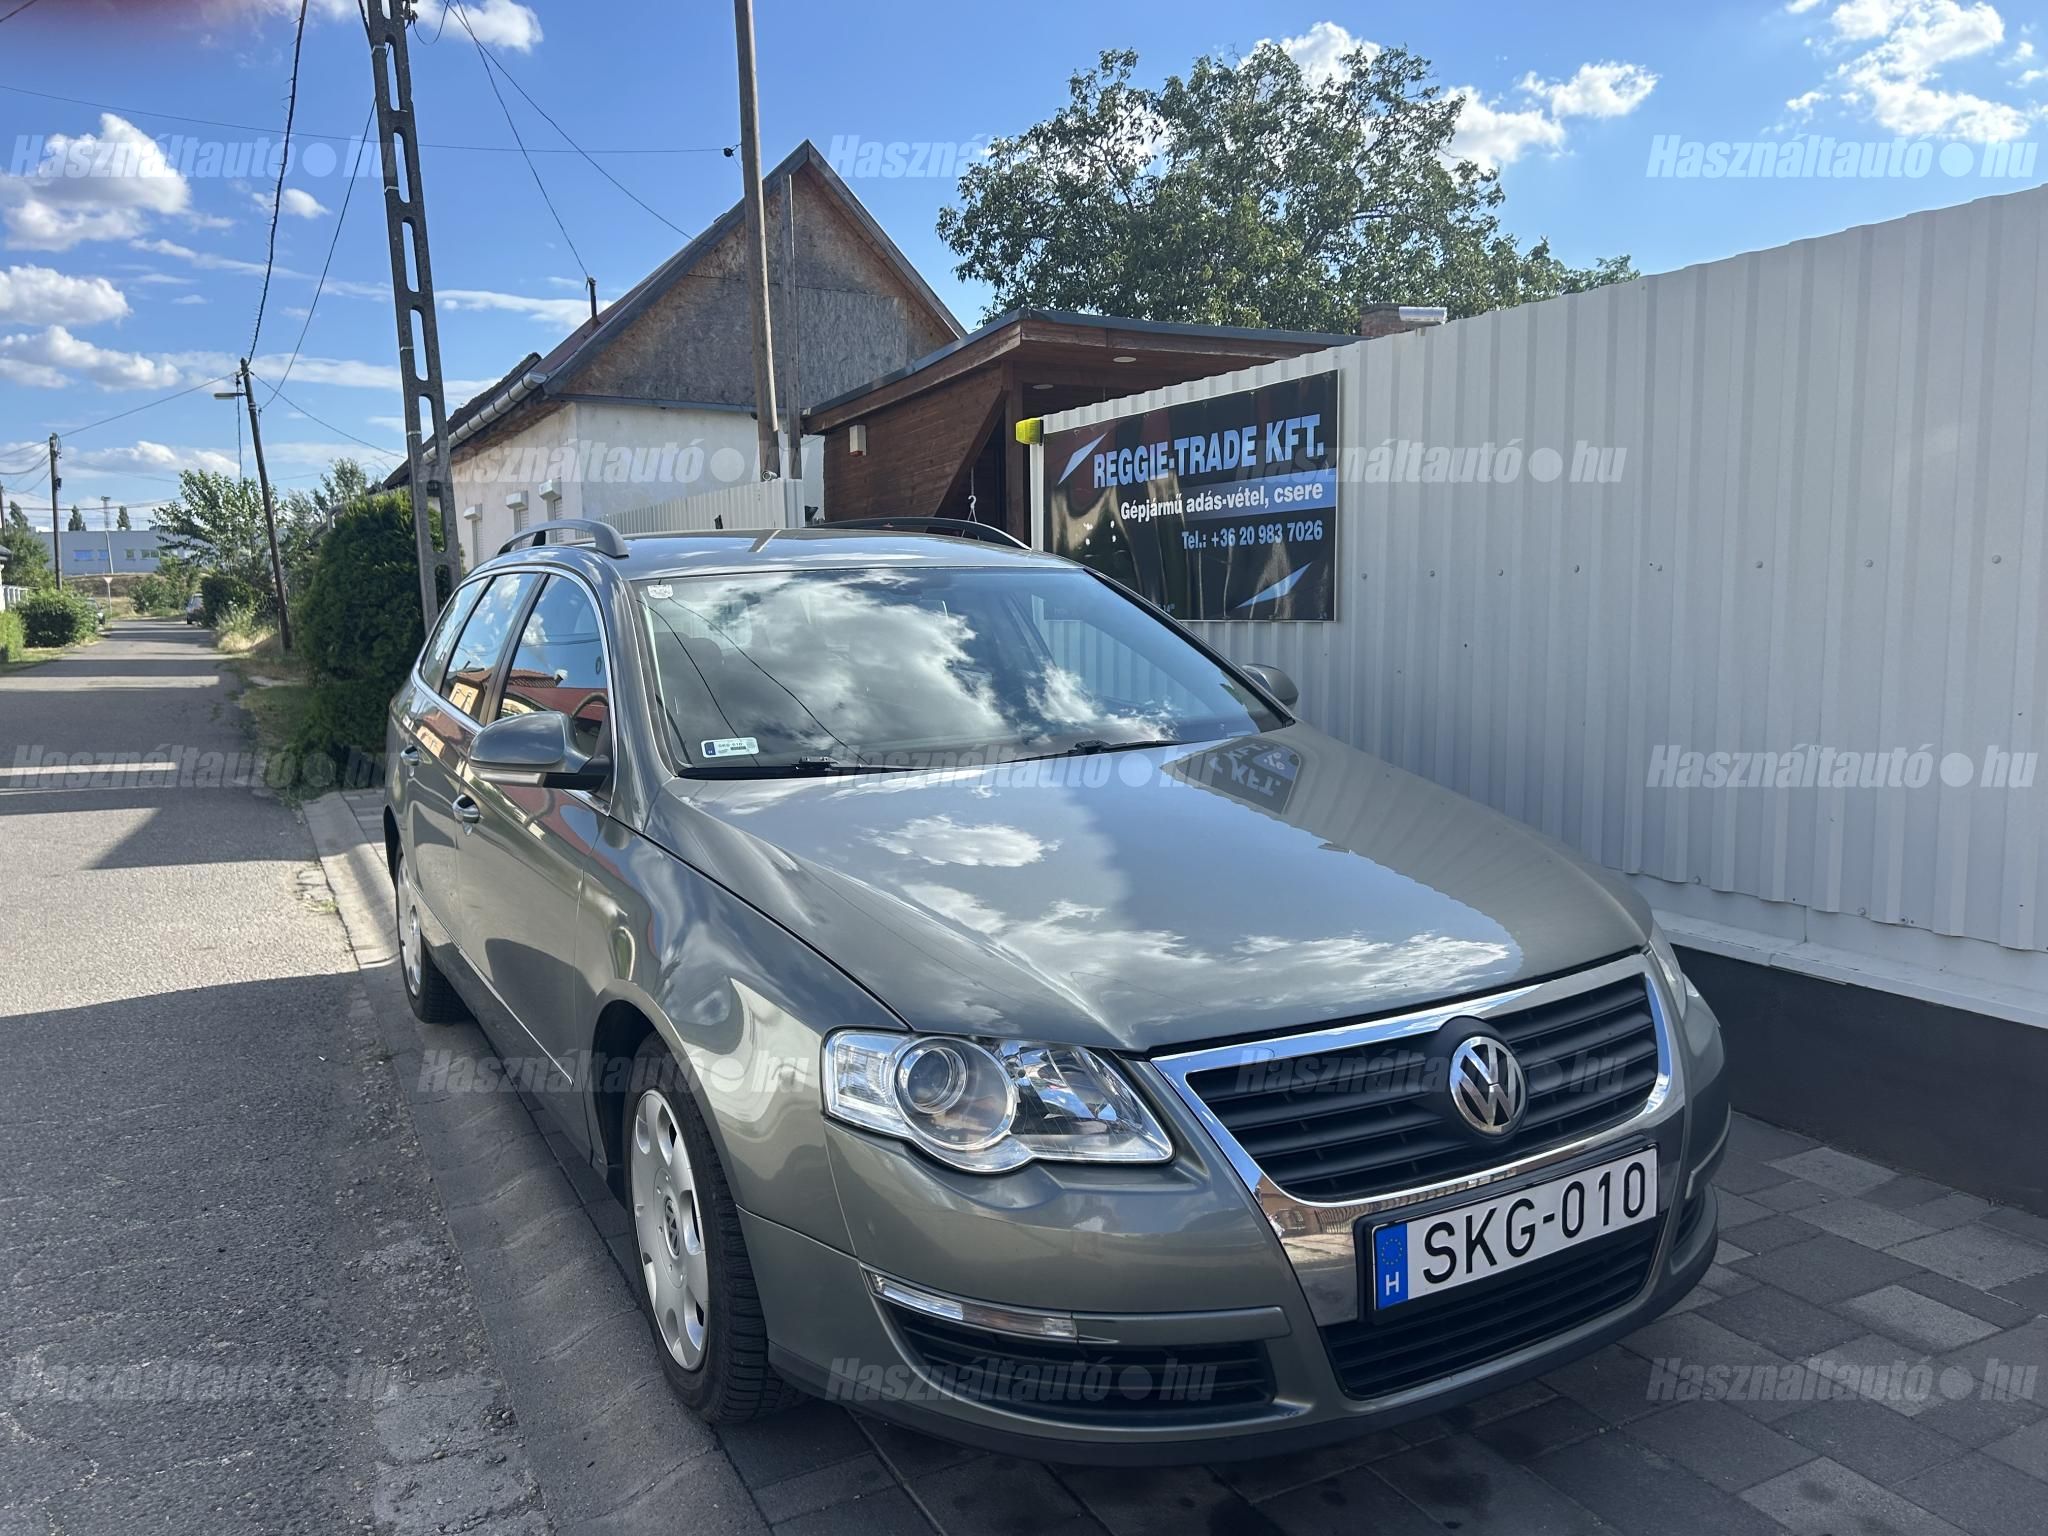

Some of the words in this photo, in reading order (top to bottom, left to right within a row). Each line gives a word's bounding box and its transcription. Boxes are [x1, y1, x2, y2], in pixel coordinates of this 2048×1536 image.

[1093, 425, 1257, 489] REGGIE-TRADE
[1265, 413, 1324, 463] KFT.
[1120, 496, 1183, 523] Gépjármű
[1186, 484, 1269, 514] adás-vétel,
[1273, 480, 1323, 505] csere
[1182, 529, 1207, 550] Tel.:
[1210, 527, 1236, 548] +36
[1239, 525, 1255, 546] 20
[1258, 523, 1283, 544] 983
[1287, 519, 1323, 542] 7026
[1423, 1161, 1646, 1285] SKG-010
[1384, 1271, 1399, 1298] H
